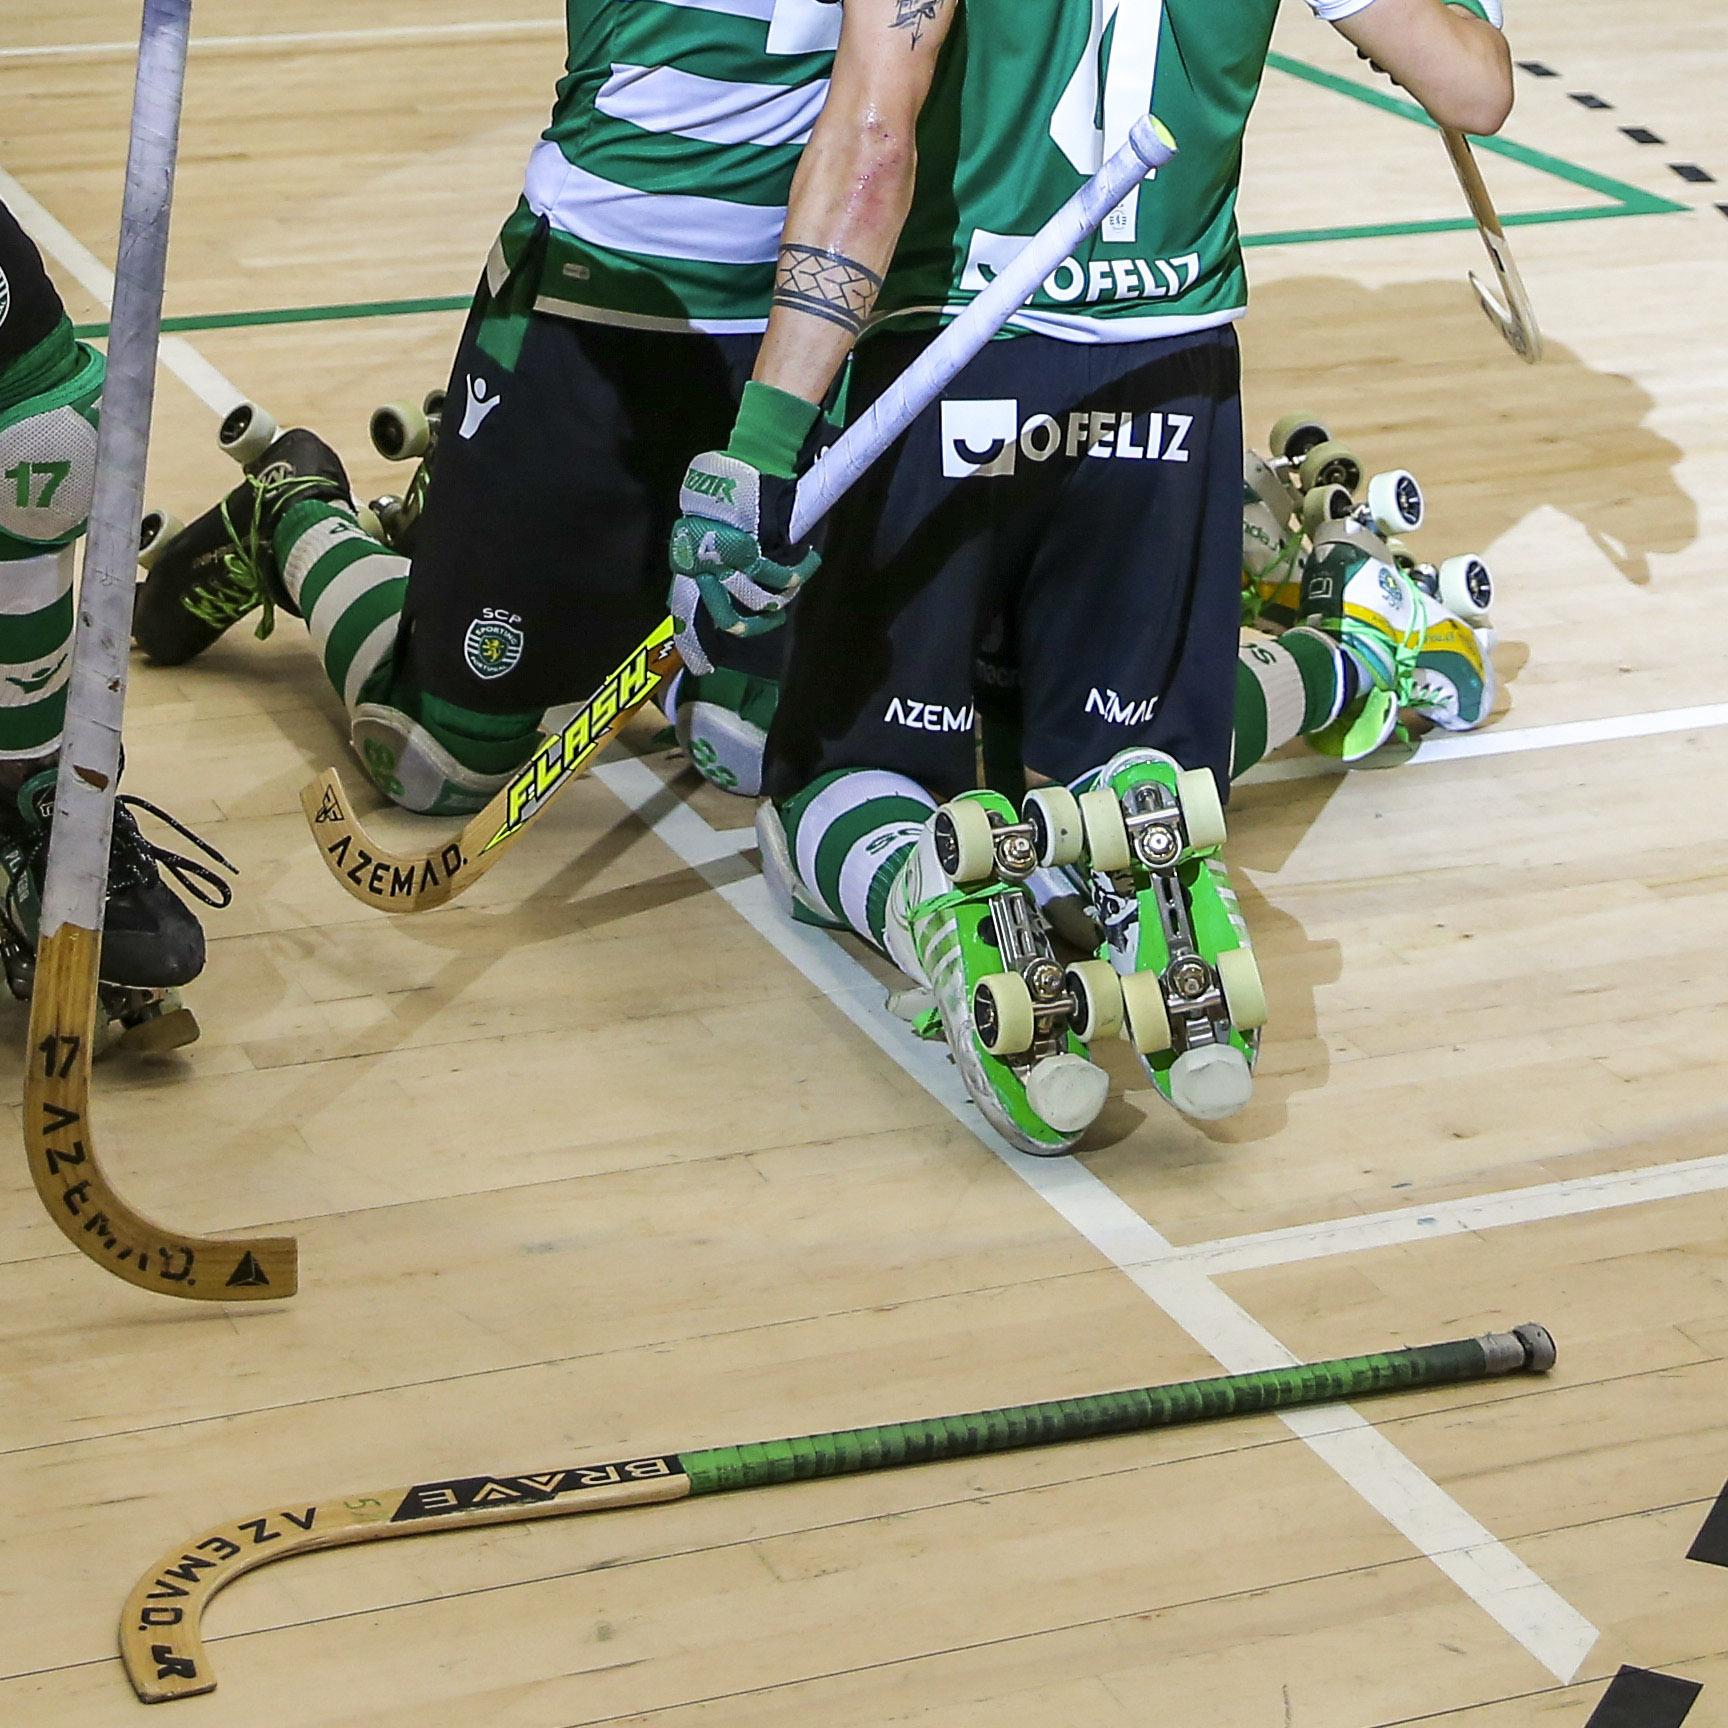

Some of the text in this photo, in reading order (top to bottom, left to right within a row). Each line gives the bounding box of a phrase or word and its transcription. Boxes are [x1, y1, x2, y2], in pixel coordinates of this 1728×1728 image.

[4, 460, 72, 509] 17
[475, 626, 518, 645] SPORTING
[482, 607, 522, 623] SCP
[506, 645, 650, 829] FLASH
[39, 1035, 80, 1079] 17
[419, 1457, 672, 1510] BRAVE
